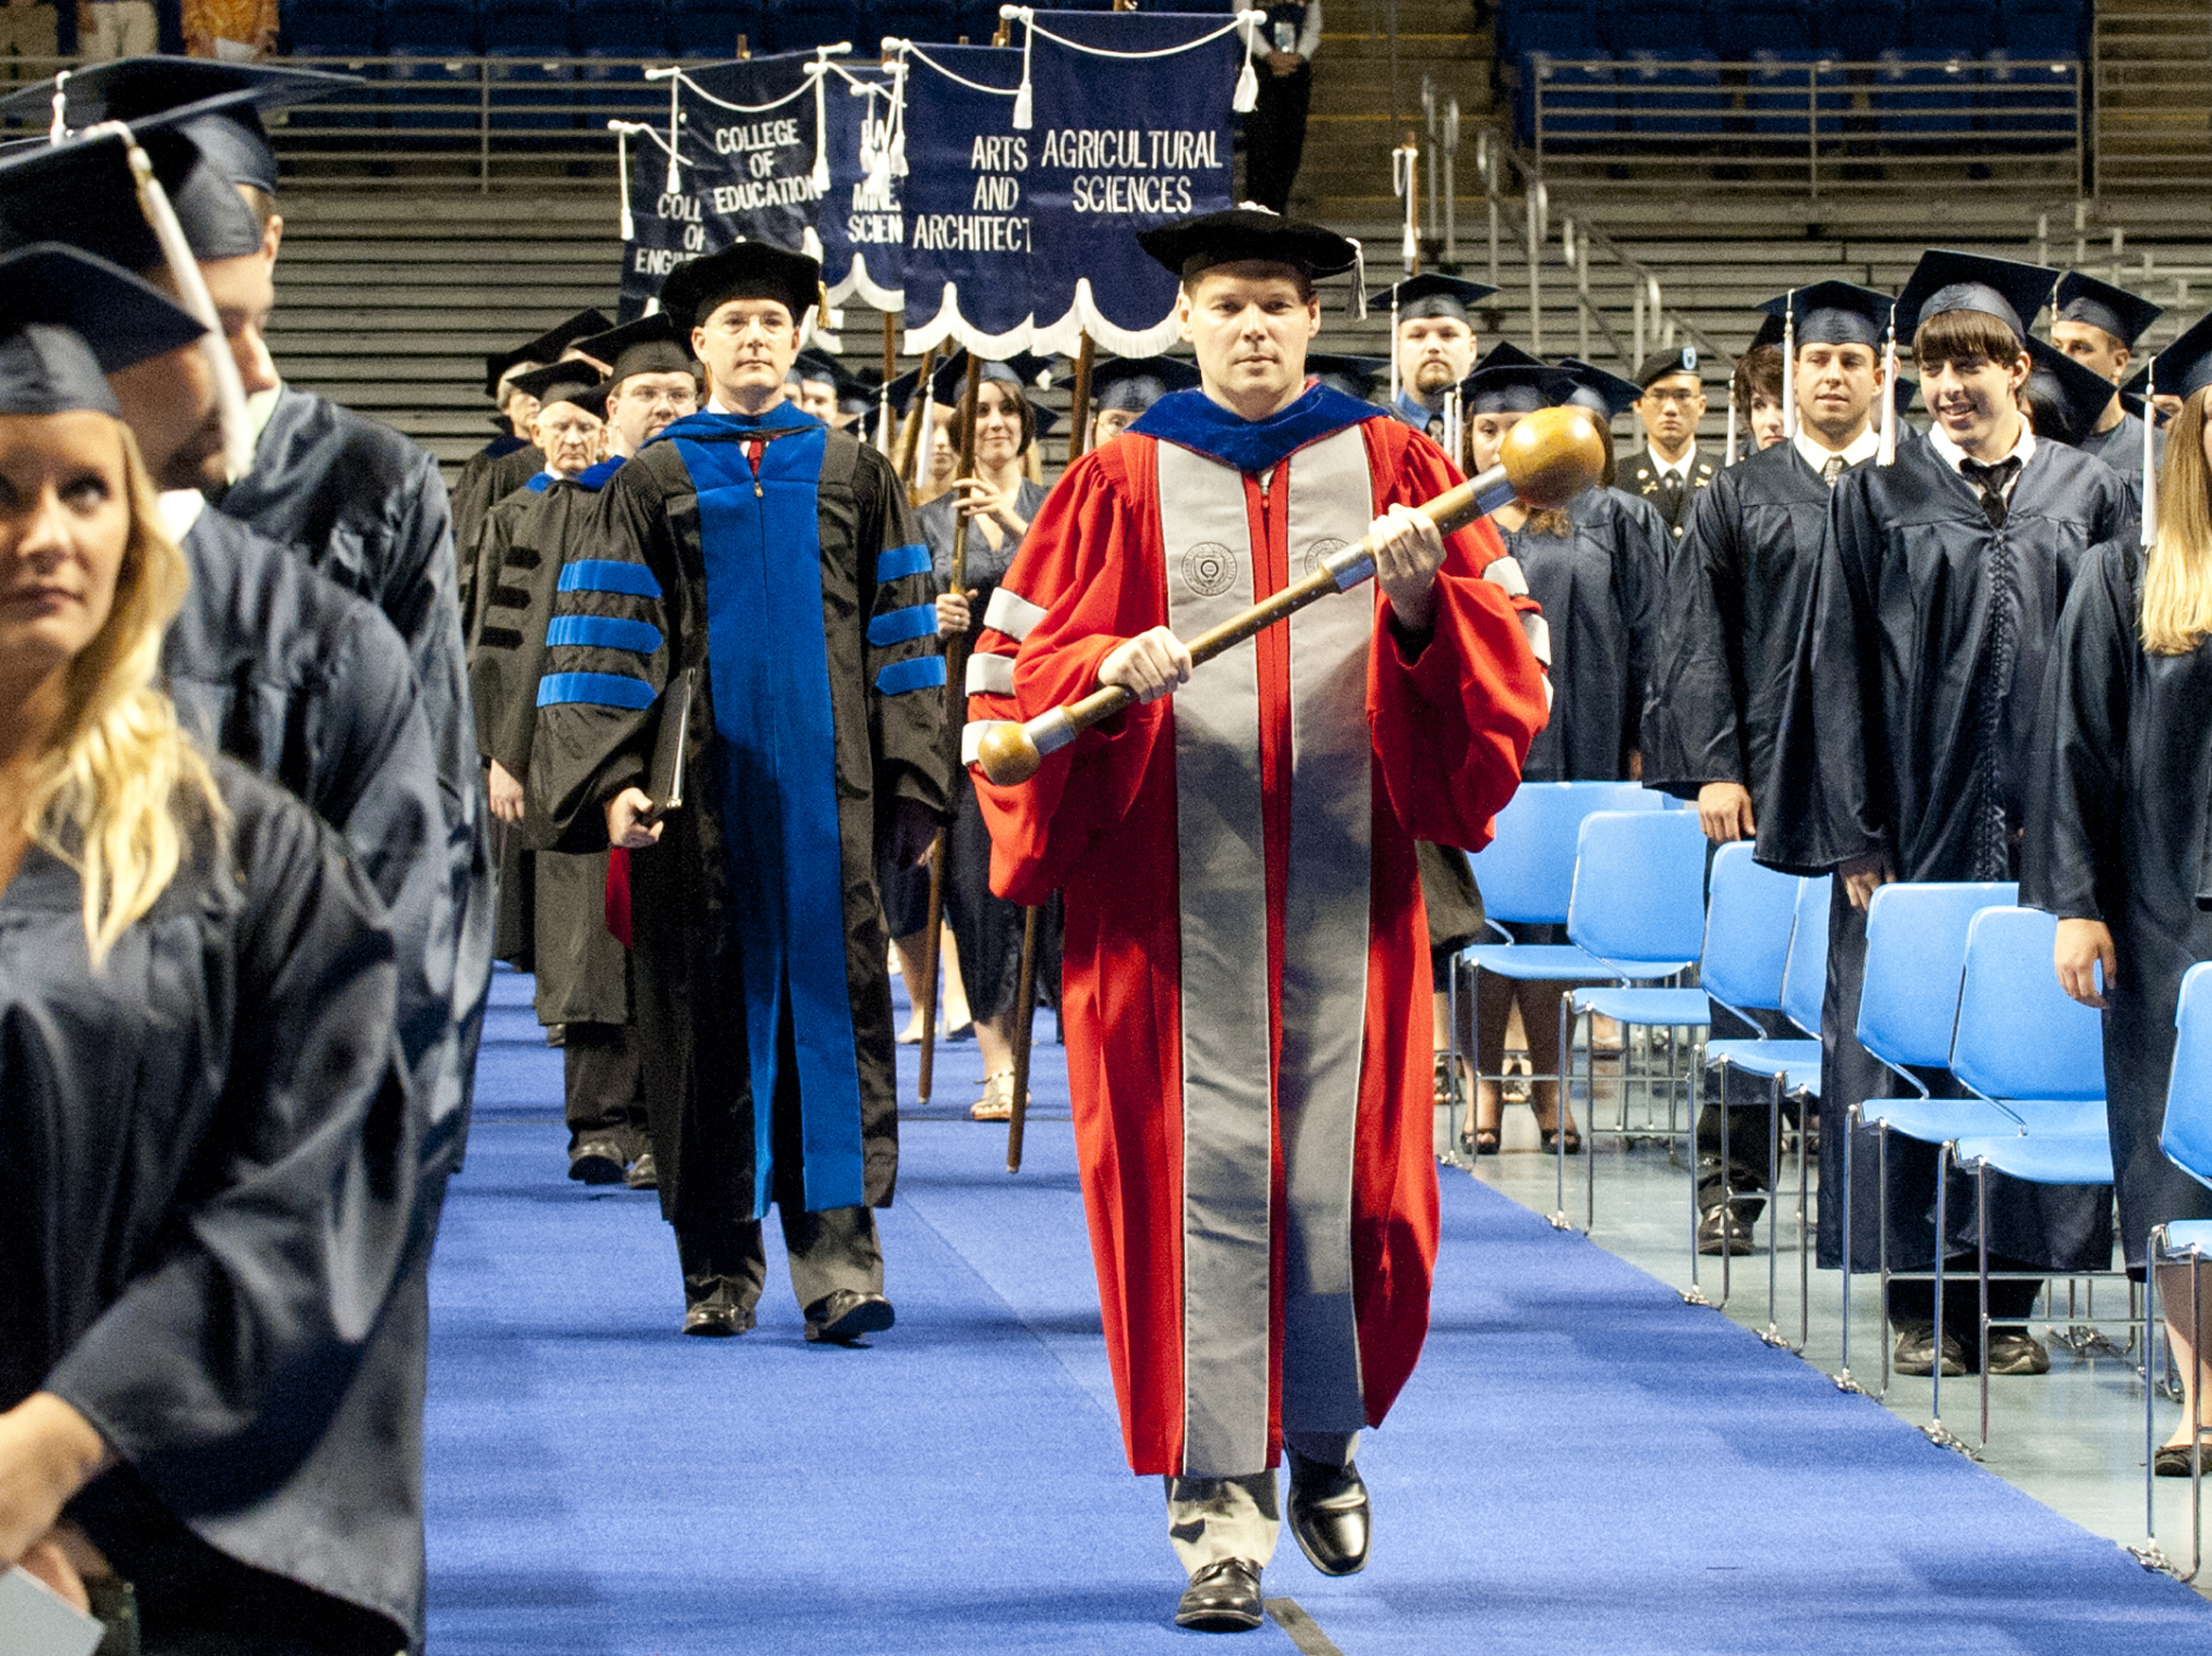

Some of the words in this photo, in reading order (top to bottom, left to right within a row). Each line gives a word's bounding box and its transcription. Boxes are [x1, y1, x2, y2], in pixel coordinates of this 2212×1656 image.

[715, 118, 800, 154] COLLEGE
[970, 135, 1029, 172] ARTS
[1040, 130, 1224, 169] AGRICULTURAL
[749, 150, 775, 178] OF
[713, 175, 823, 214] EDUCATION
[972, 175, 1019, 211] AND
[1071, 175, 1192, 213] SCIENCES
